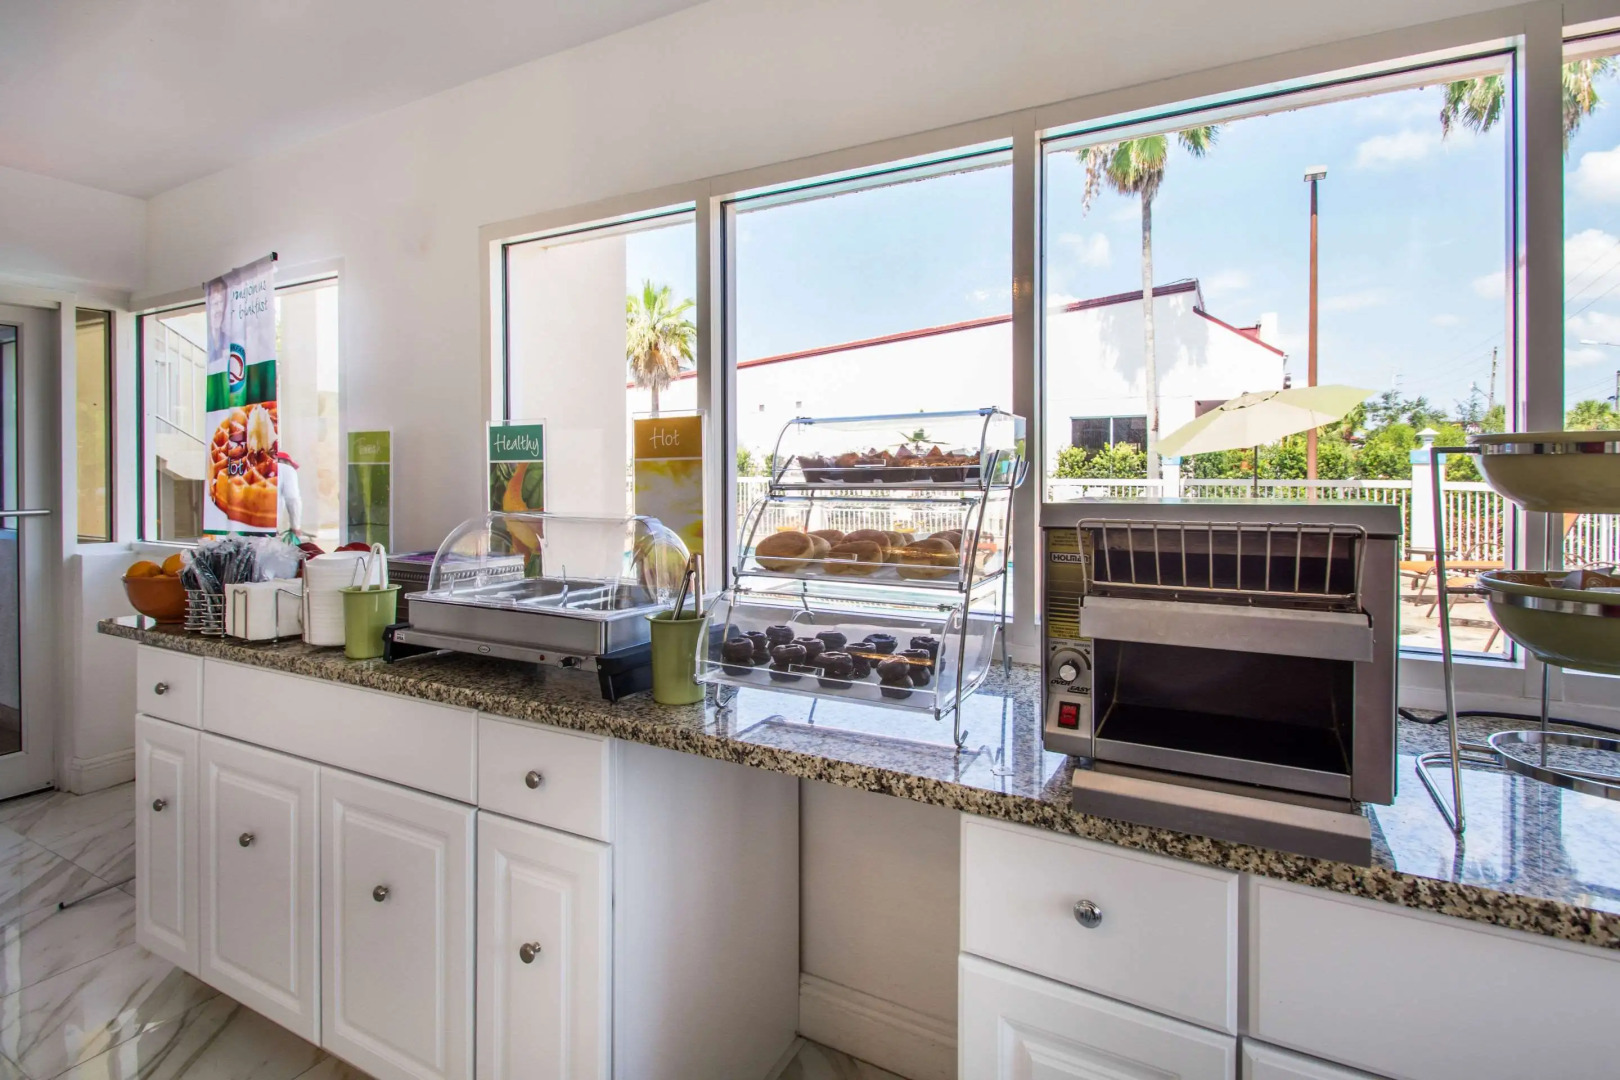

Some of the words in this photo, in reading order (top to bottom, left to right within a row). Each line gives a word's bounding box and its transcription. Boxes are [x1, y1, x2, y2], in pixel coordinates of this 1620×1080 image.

[493, 433, 540, 457] Healthy
[649, 426, 680, 449] Hot
[1069, 685, 1091, 693] EASY
